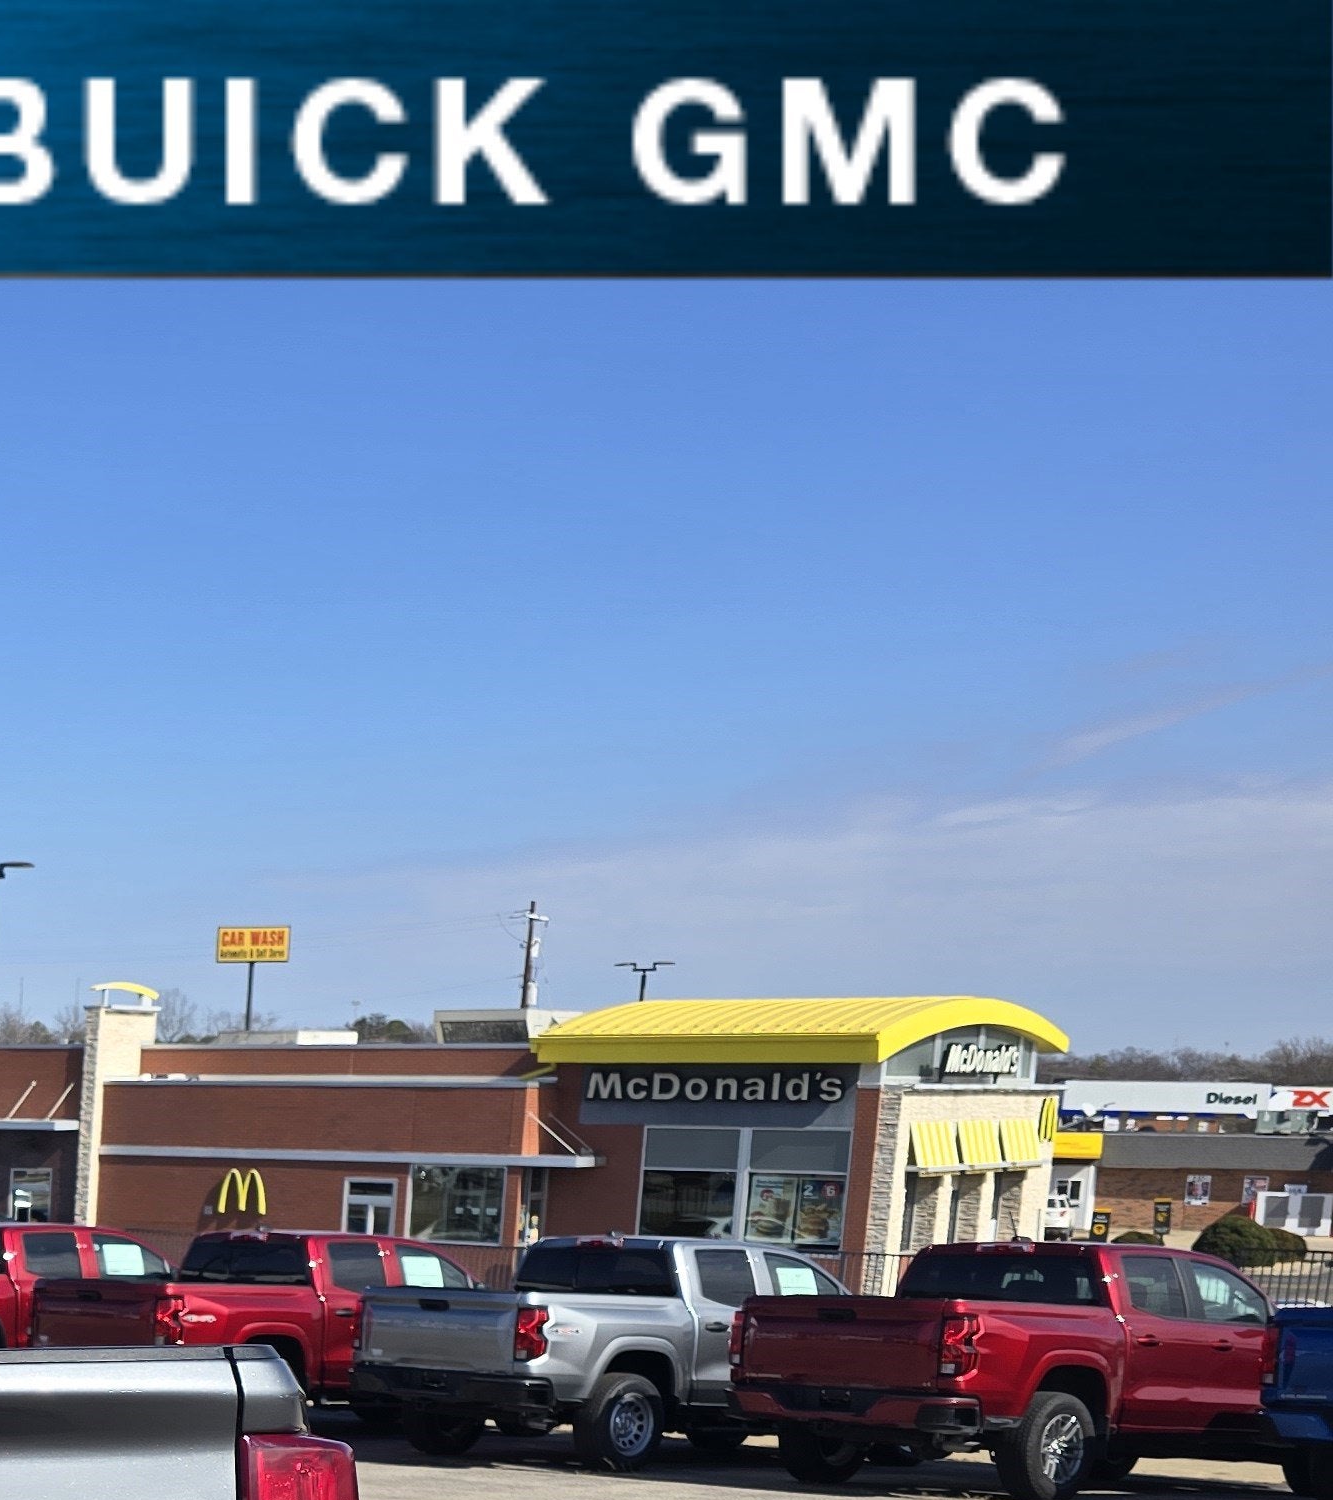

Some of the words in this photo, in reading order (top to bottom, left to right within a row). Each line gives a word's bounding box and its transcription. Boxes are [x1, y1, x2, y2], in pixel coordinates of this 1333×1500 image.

[221, 931, 245, 947] CAR
[249, 931, 286, 947] WASH
[946, 1043, 1021, 1074] McDonald's
[586, 1071, 843, 1102] McDonald's
[1206, 1091, 1258, 1105] Diesel
